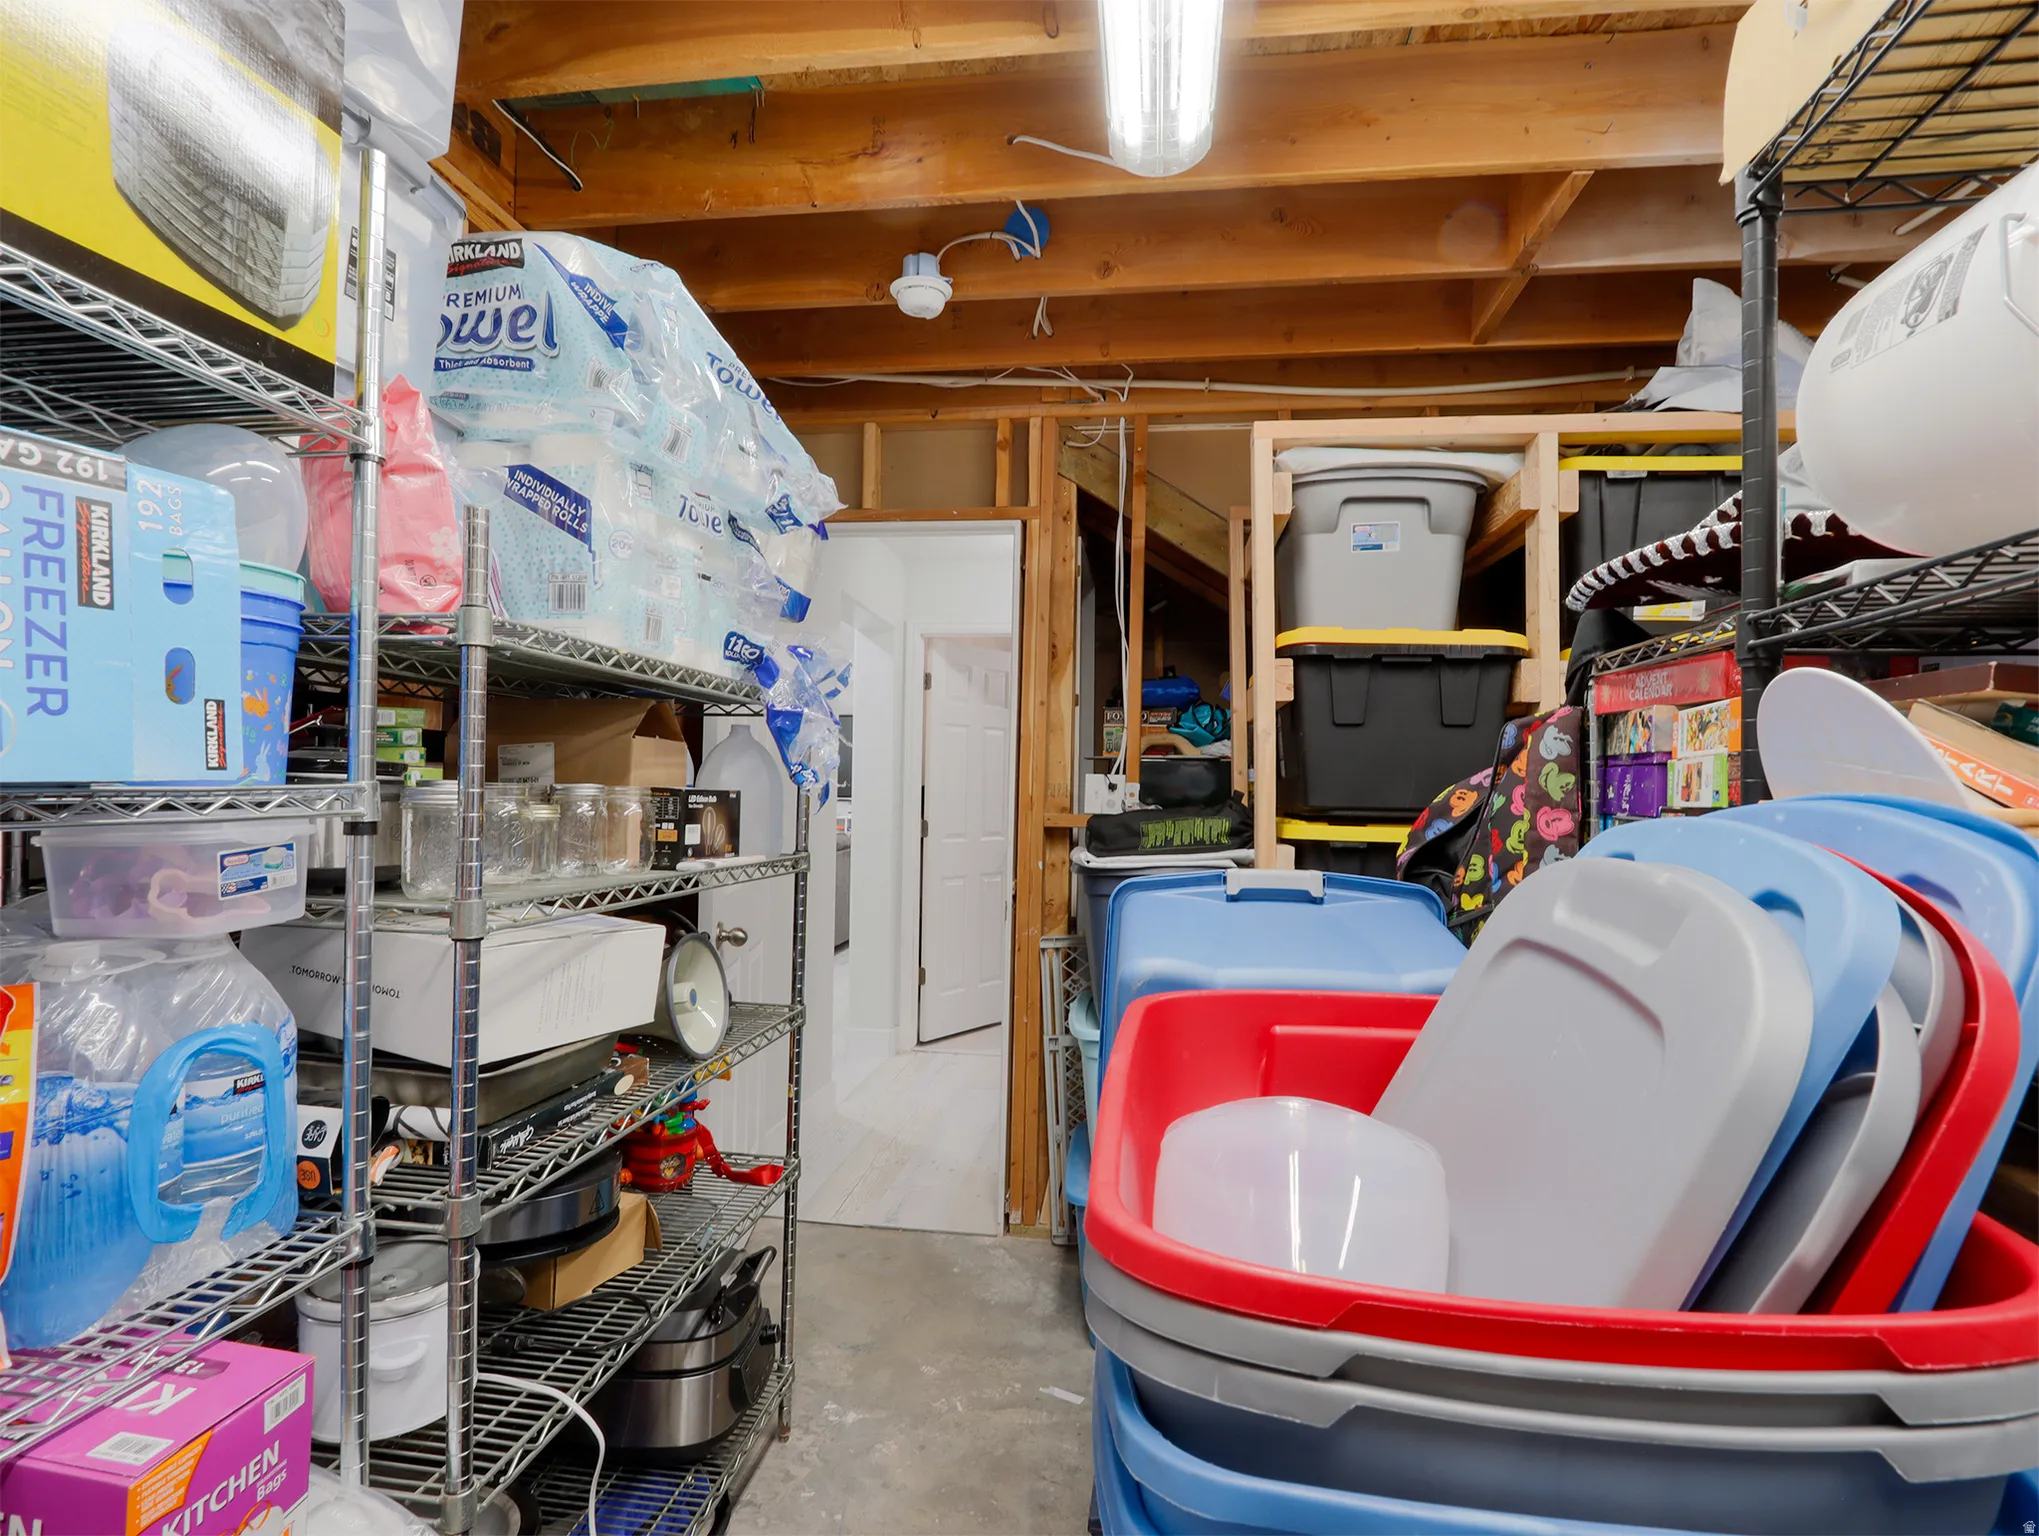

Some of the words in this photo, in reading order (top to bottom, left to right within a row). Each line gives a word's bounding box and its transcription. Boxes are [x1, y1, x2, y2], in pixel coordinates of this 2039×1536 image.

[449, 241, 522, 263] IRKLAND
[443, 283, 523, 308] REMIUM
[481, 355, 530, 369] Absorbent
[706, 351, 780, 421] Towe
[137, 478, 163, 532] 192
[168, 485, 183, 537] BAGS
[514, 469, 587, 517] INDIVIDUALLY
[552, 504, 588, 534] ROLLS
[76, 502, 93, 604] Signature
[90, 504, 111, 607] KIRKLAND
[22, 484, 69, 717] FREEZER
[1629, 683, 1673, 701] CALENDAR
[1635, 671, 1668, 687] ADVENT
[206, 701, 219, 768] KIRKLAND
[161, 1439, 280, 1536] KITCHEN
[257, 1468, 287, 1502] Bags
